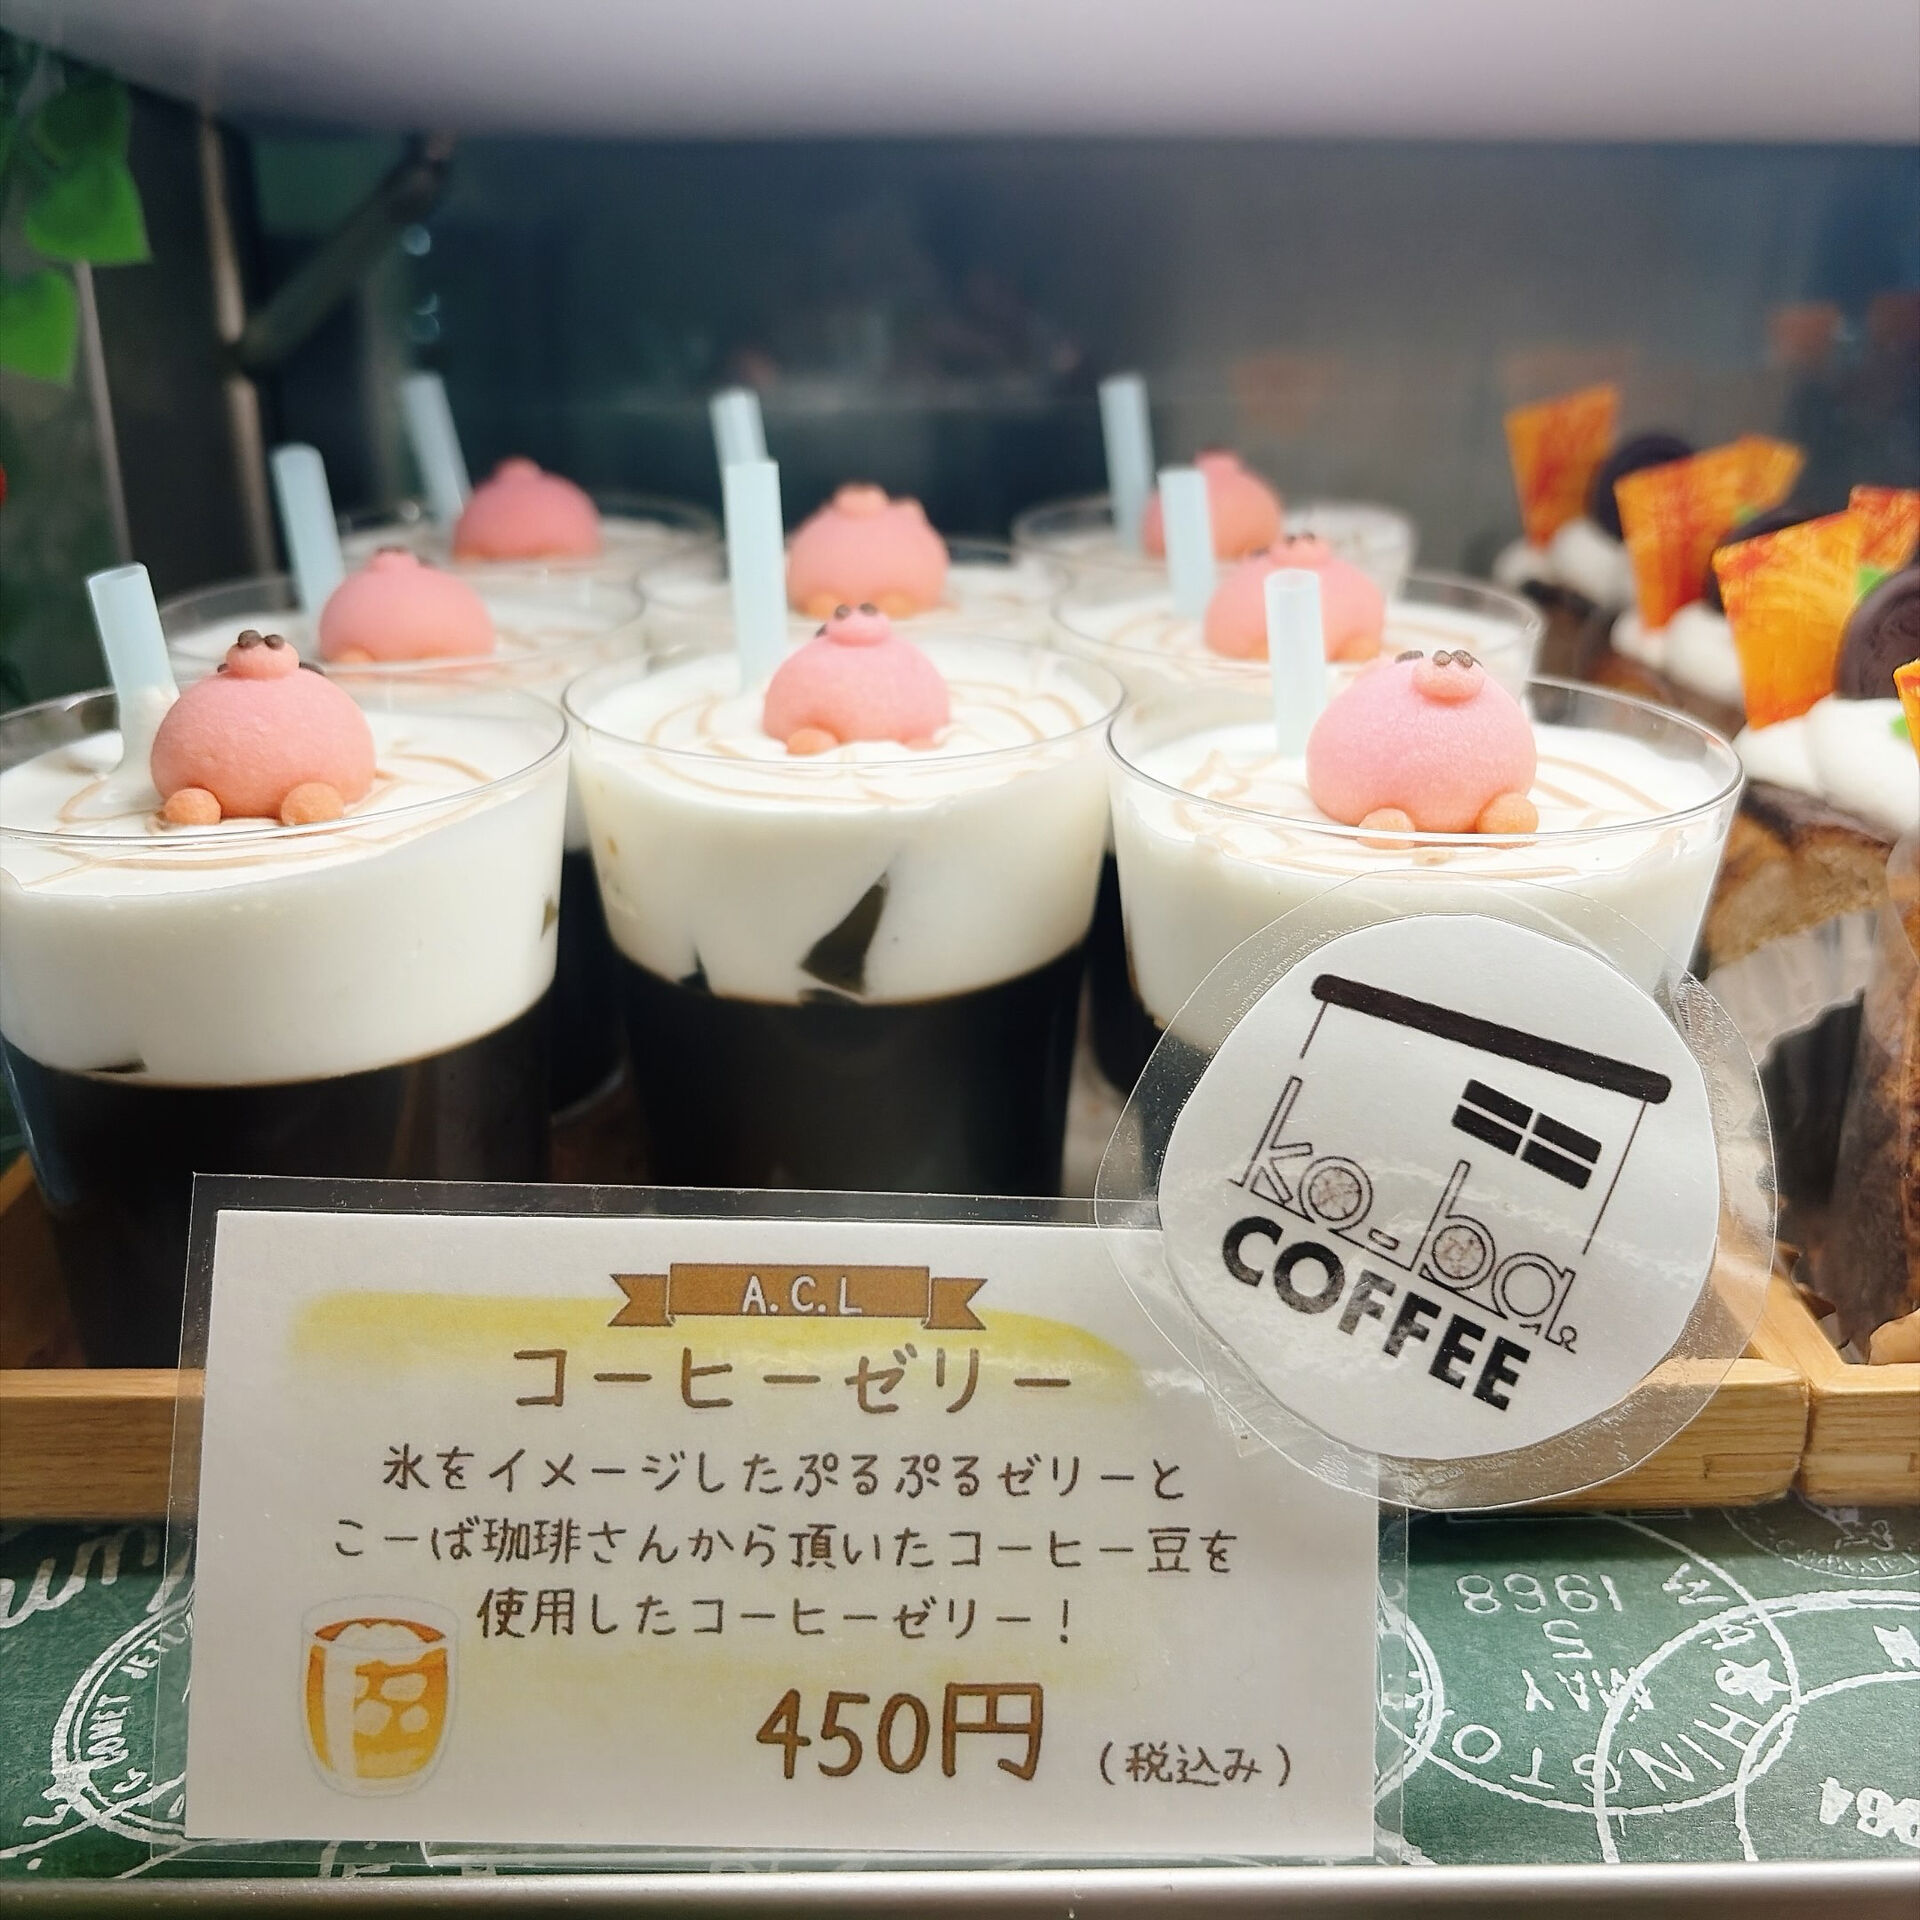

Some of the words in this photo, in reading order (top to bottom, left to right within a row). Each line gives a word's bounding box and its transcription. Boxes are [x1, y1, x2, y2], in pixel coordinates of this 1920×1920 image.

[1222, 1215, 1532, 1411] COFFEE
[513, 1343, 1072, 1415] コーヒーゼリー
[382, 1443, 1185, 1500] 氷をイメージしたぷるぷるゼリーと
[335, 1516, 1238, 1574] こーば珈琲さんから頂いたコーヒー豆を
[1455, 1573, 1624, 1613] 1968
[756, 1682, 1044, 1781] 450円
